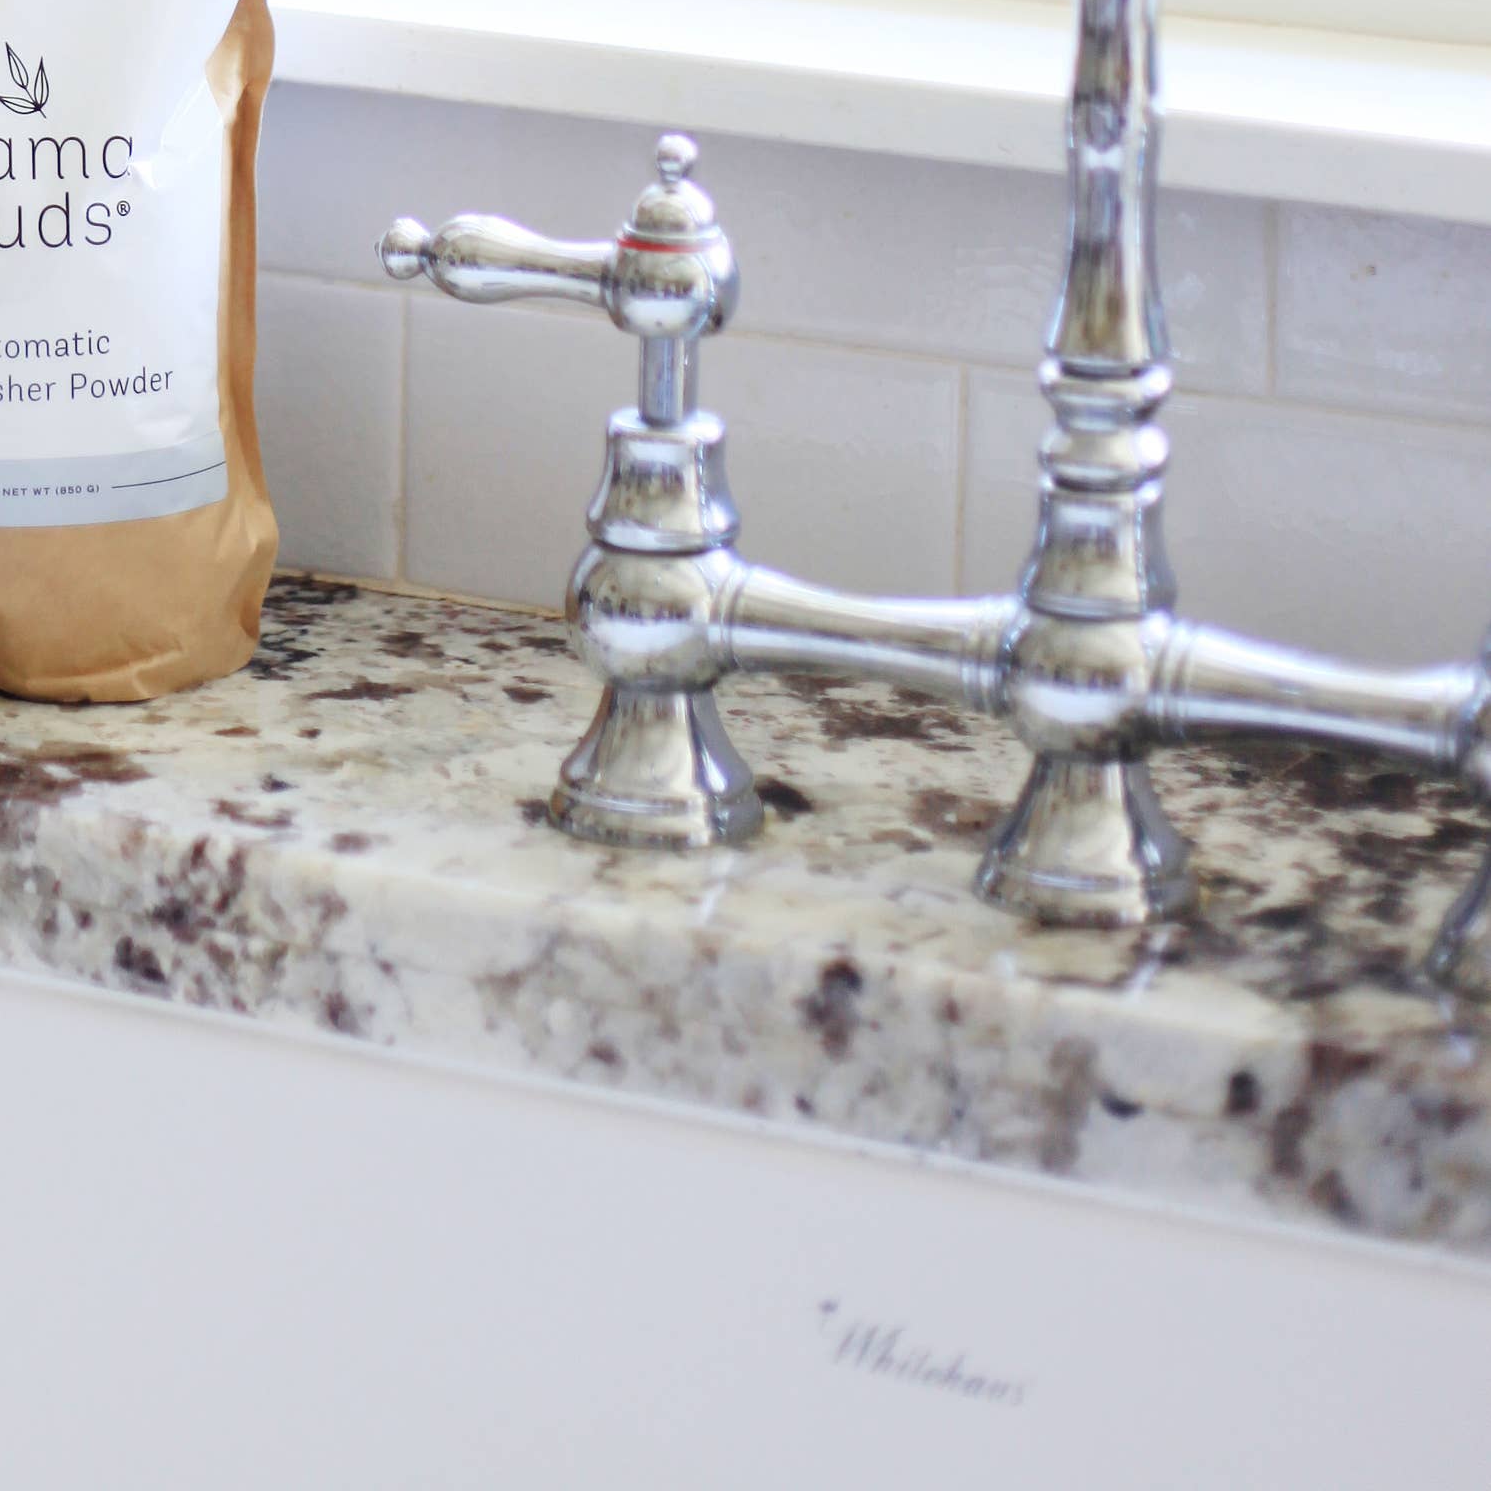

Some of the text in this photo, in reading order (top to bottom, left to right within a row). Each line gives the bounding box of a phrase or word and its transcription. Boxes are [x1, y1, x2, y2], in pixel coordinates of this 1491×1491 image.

[70, 365, 174, 401] Powder
[2, 487, 28, 497] NET
[33, 486, 51, 496] WT
[55, 485, 83, 496] (850
